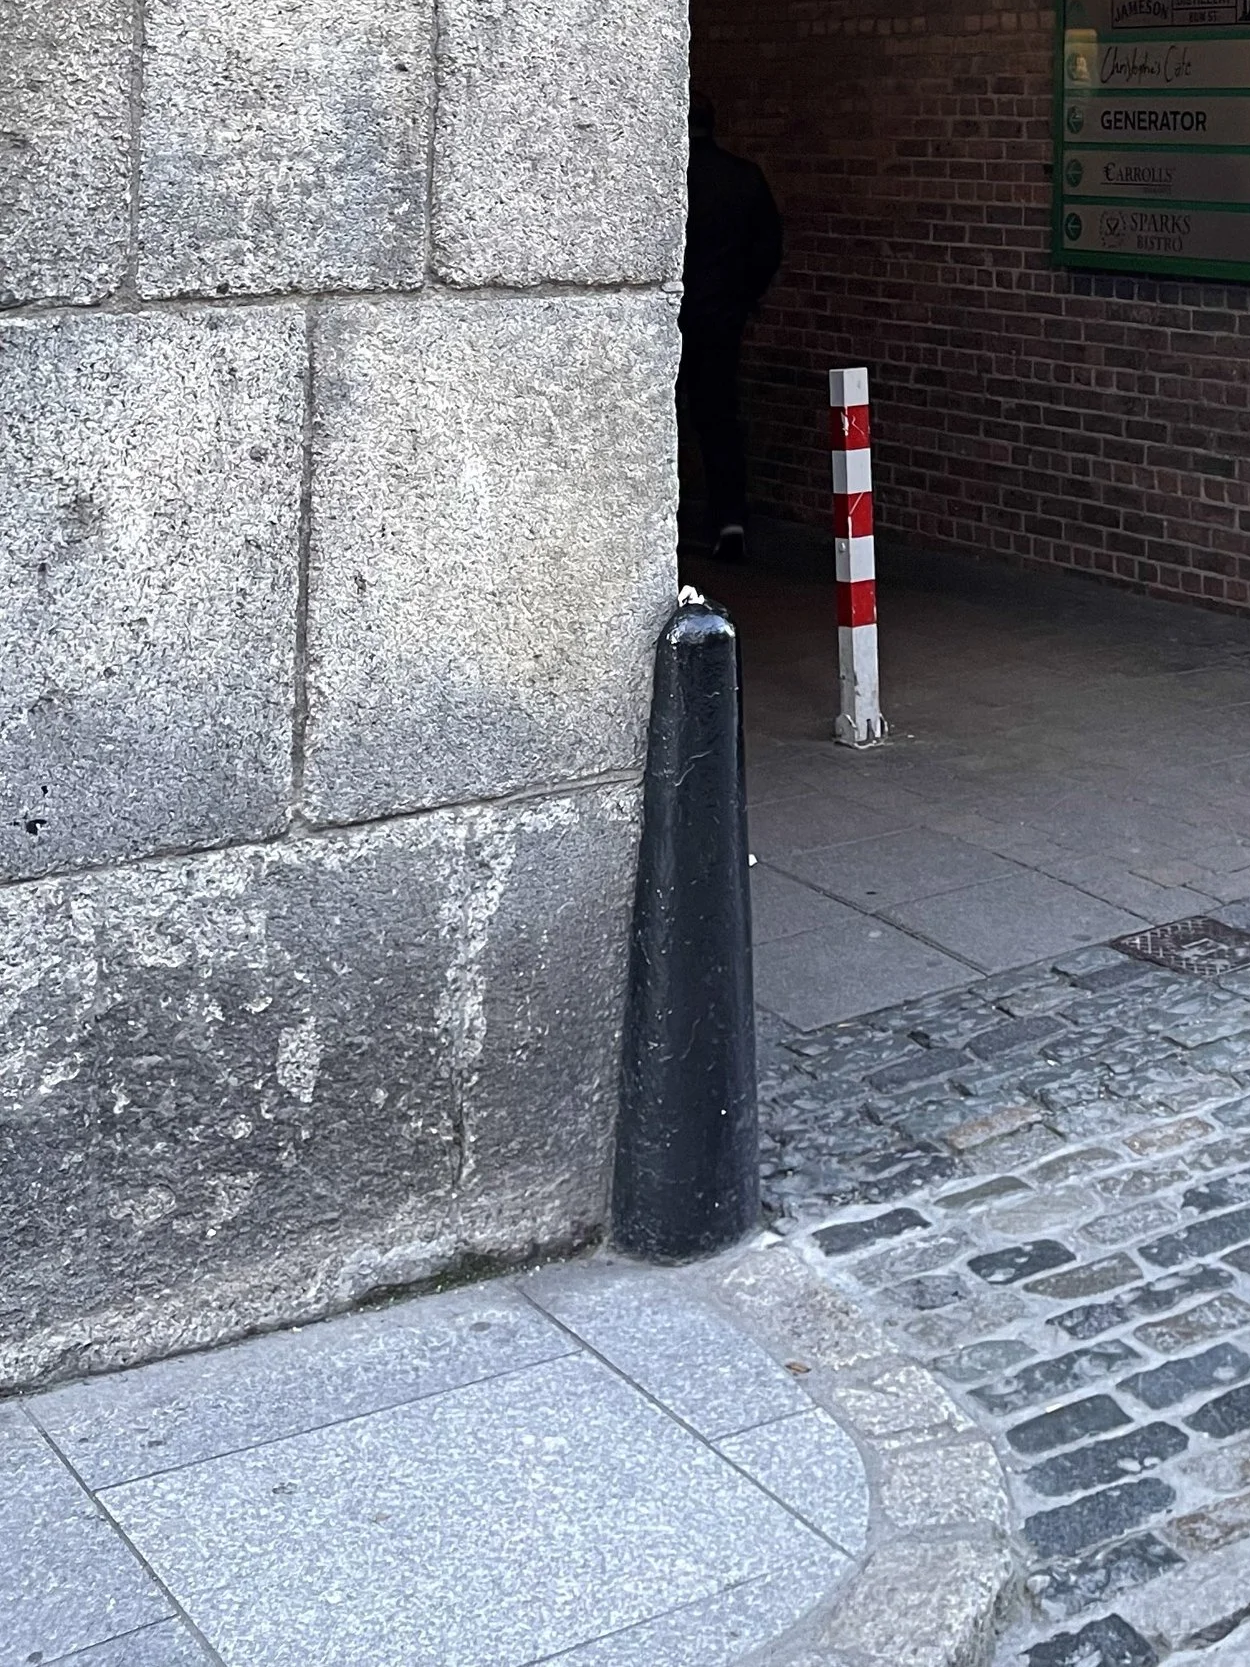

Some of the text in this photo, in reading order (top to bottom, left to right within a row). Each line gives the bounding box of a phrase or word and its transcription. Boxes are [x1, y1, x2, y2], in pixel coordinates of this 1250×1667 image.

[1114, 0, 1169, 22] JAMESON
[1100, 109, 1207, 133] GENERATOR
[1130, 212, 1191, 235] SPARKS
[1136, 234, 1184, 253] BISTRO
